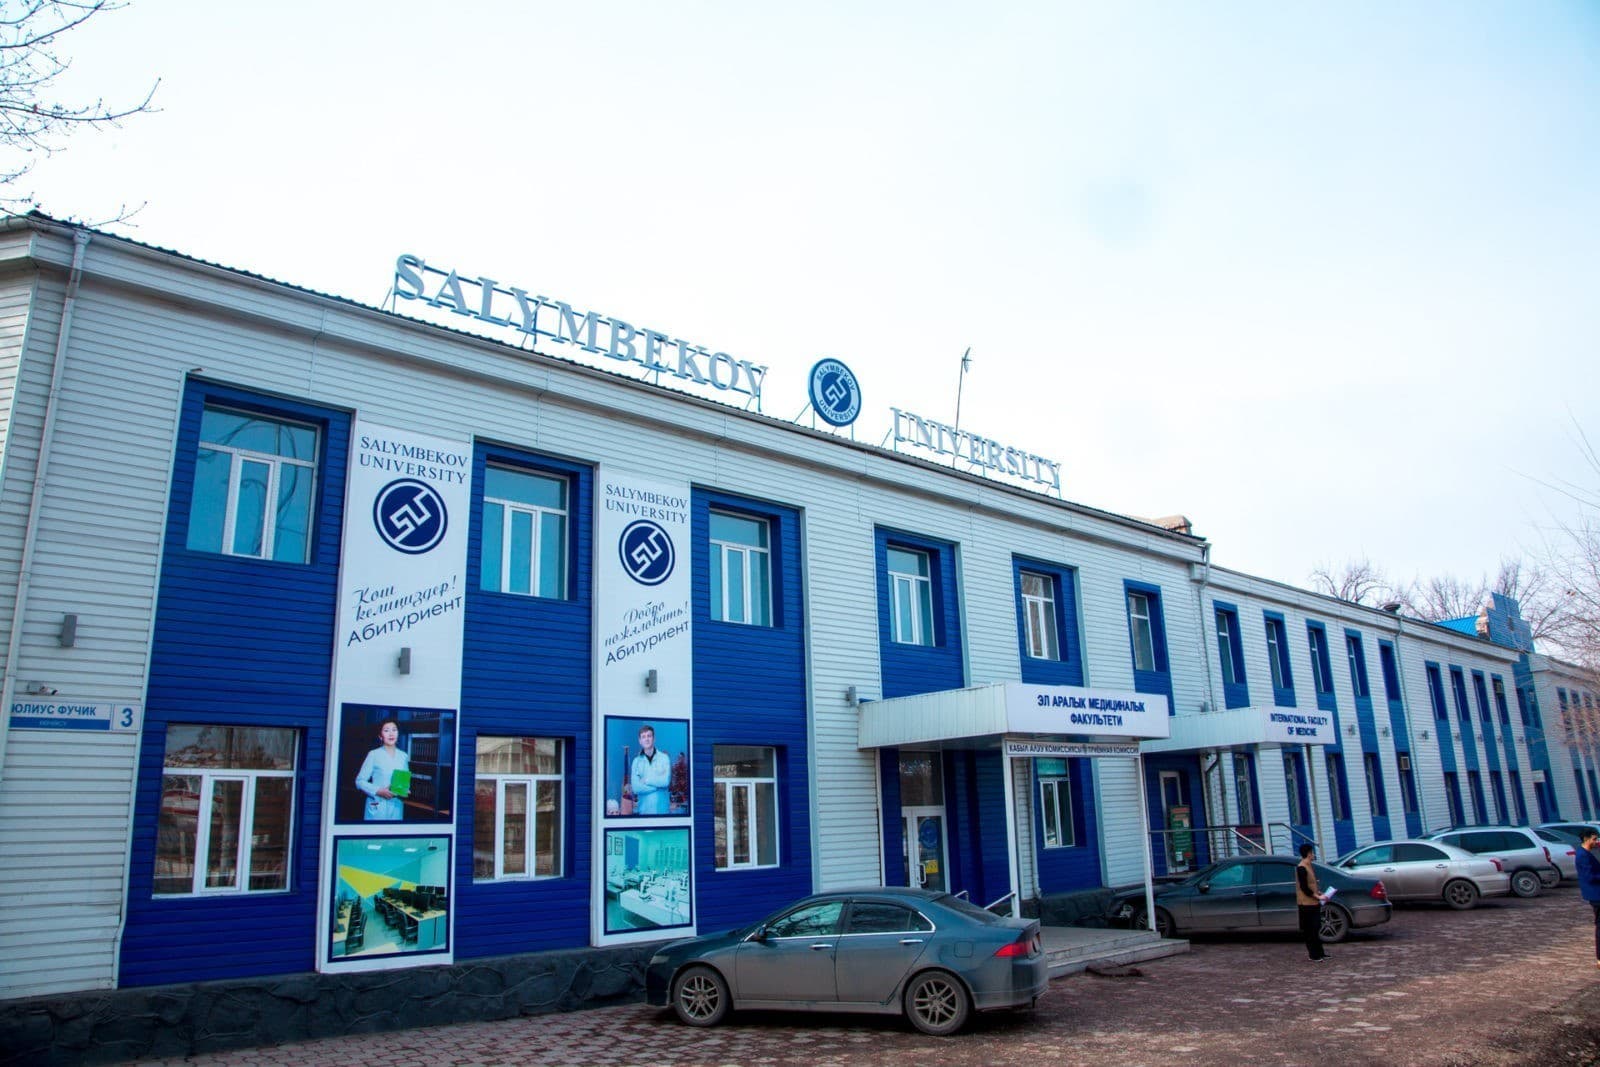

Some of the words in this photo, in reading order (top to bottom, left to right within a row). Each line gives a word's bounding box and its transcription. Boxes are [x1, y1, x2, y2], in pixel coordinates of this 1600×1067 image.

[395, 253, 768, 398] SALYMBEKOV
[816, 363, 856, 391] SALYMBEKOV
[819, 399, 856, 421] UNIVERSITY
[360, 436, 468, 467] SALYMBEKOV
[890, 406, 1062, 489] UNIVERSITY
[360, 453, 466, 484] UNIVERSITY
[606, 484, 689, 509] SALYMBEKOV
[605, 499, 687, 524] UNIVERSITY
[347, 596, 463, 647] Абитуриент
[623, 601, 665, 624] Добро
[605, 620, 689, 667] Абитуриент
[11, 703, 55, 714] ЮЛИУС
[57, 705, 97, 716] ФУЧИК
[1037, 694, 1050, 707] ЭЛ
[1052, 695, 1086, 709] АРАЛЫК
[1088, 698, 1146, 712] МЕДИЦИНАЛЫК
[121, 707, 133, 728] 3
[1070, 713, 1123, 726] ФАКУЛЬТЕТИ
[1307, 716, 1328, 725] FACULTY
